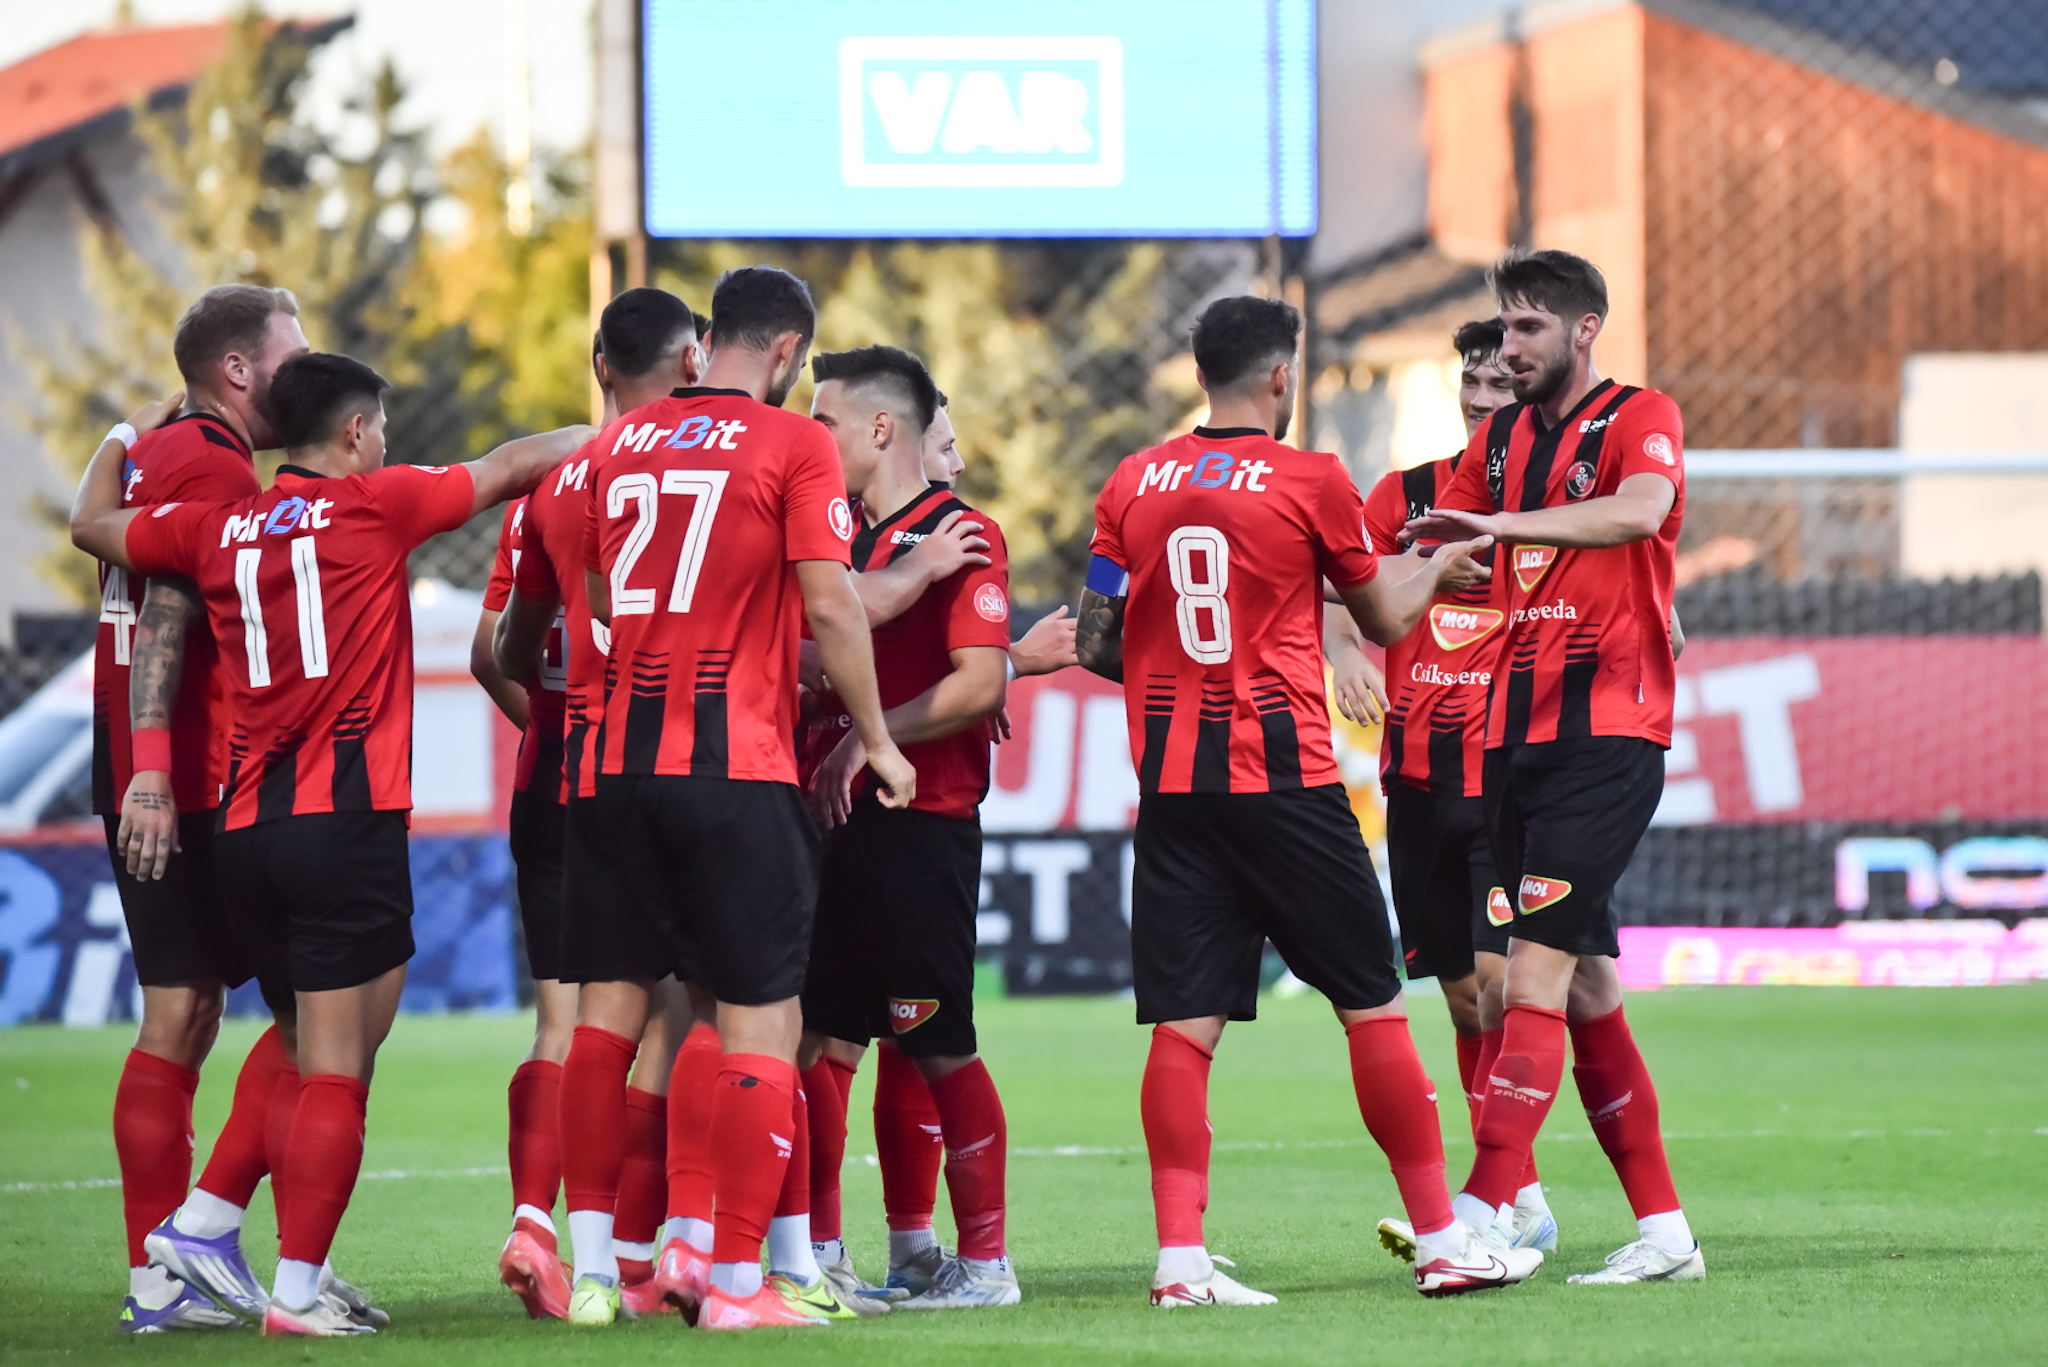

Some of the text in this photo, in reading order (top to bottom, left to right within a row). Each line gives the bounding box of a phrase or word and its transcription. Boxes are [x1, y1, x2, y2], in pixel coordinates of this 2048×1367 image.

[869, 71, 1093, 154] VAR
[611, 415, 748, 456] MrBit
[1137, 451, 1273, 496] MrBit
[219, 496, 334, 548] MrBit
[607, 469, 730, 617] 27
[235, 536, 328, 688] 11
[1167, 525, 1232, 665] 8
[1439, 611, 1479, 630] MOL
[1522, 880, 1549, 897] MOL
